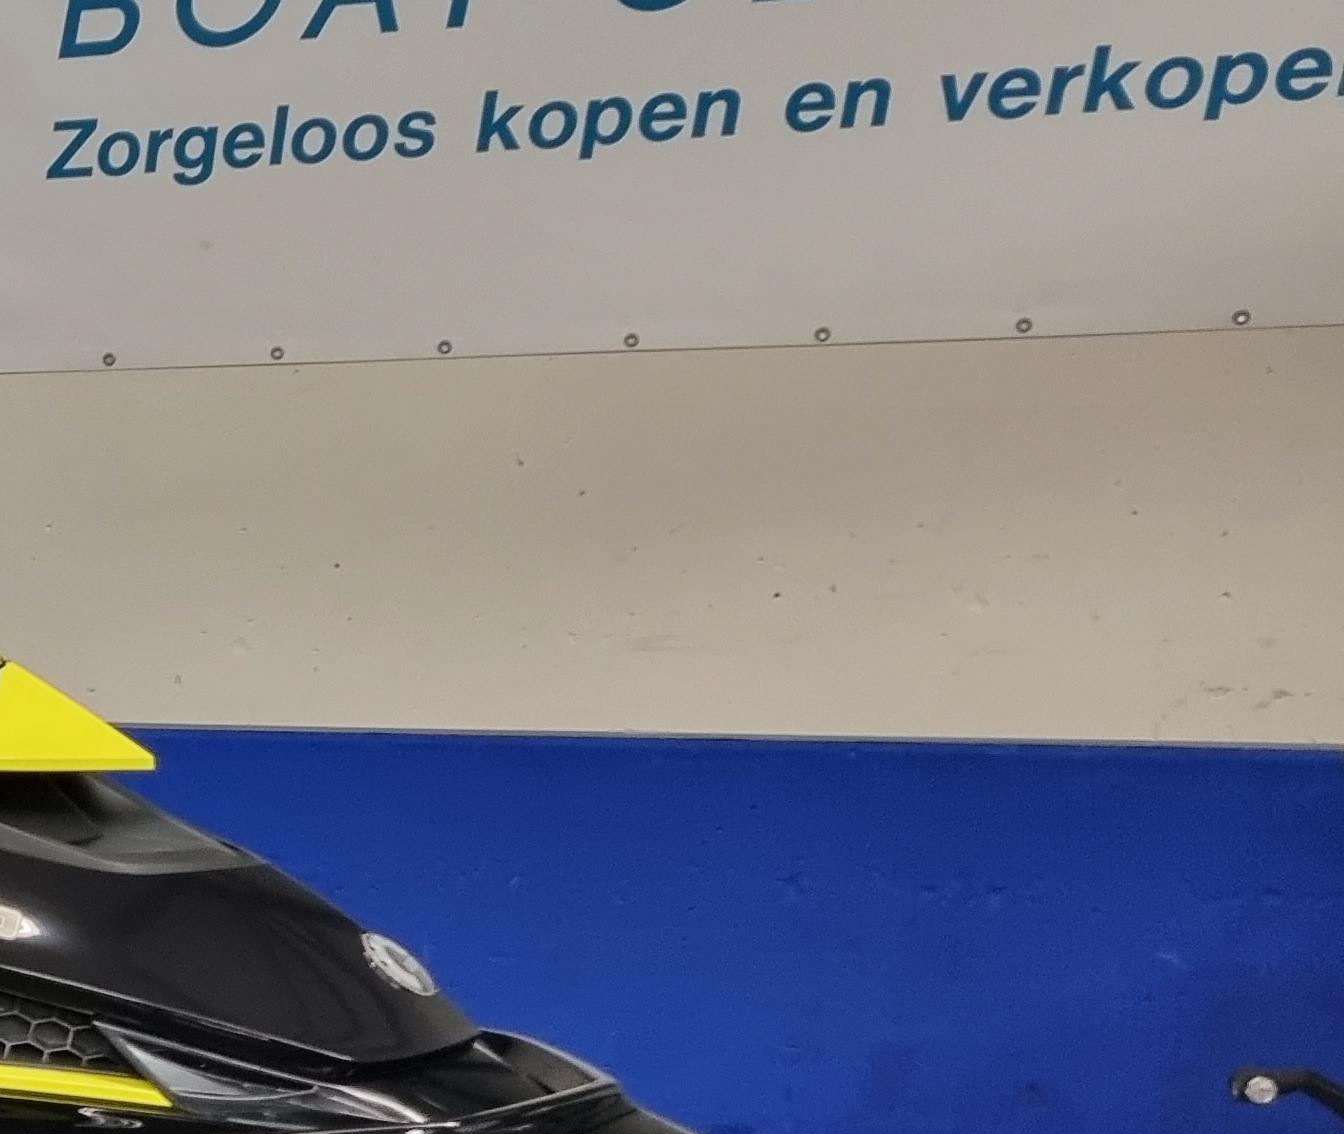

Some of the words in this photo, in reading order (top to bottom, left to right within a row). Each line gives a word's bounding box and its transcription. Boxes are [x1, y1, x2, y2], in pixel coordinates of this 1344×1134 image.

[46, 104, 436, 187] Zorgeloos
[476, 88, 742, 160] kopen
[784, 76, 892, 133] en
[940, 45, 1344, 121] verkope
